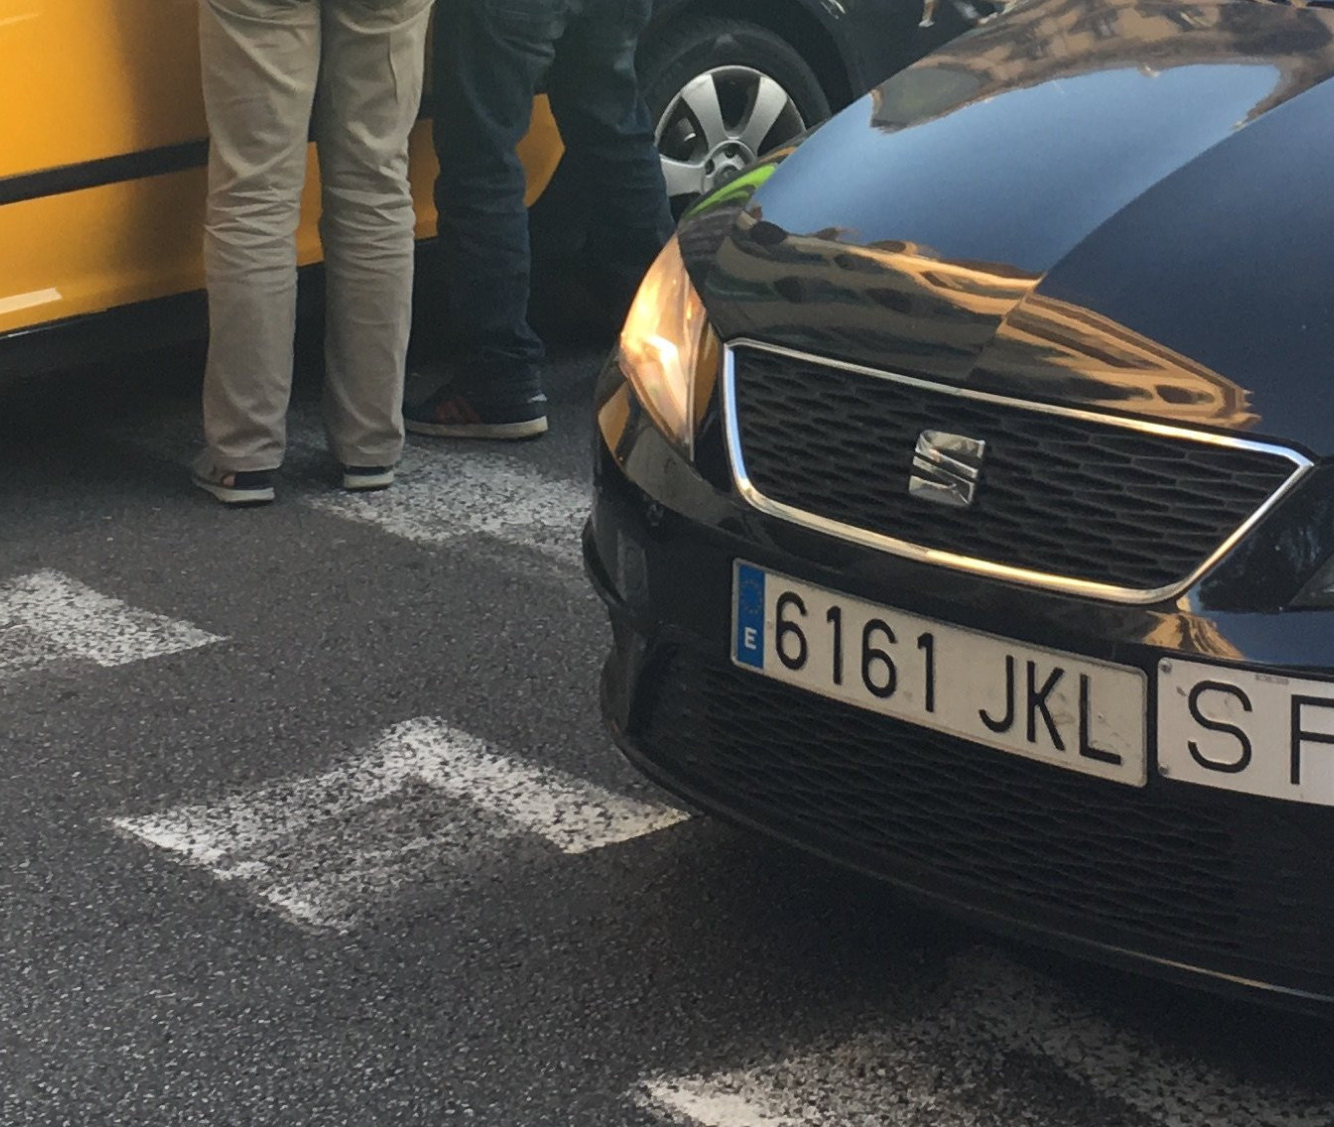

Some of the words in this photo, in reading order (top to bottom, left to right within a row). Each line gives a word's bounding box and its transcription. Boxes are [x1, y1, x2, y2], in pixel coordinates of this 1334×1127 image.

[743, 625, 758, 651] E
[774, 590, 936, 714] 6161
[977, 653, 1123, 767] JKL
